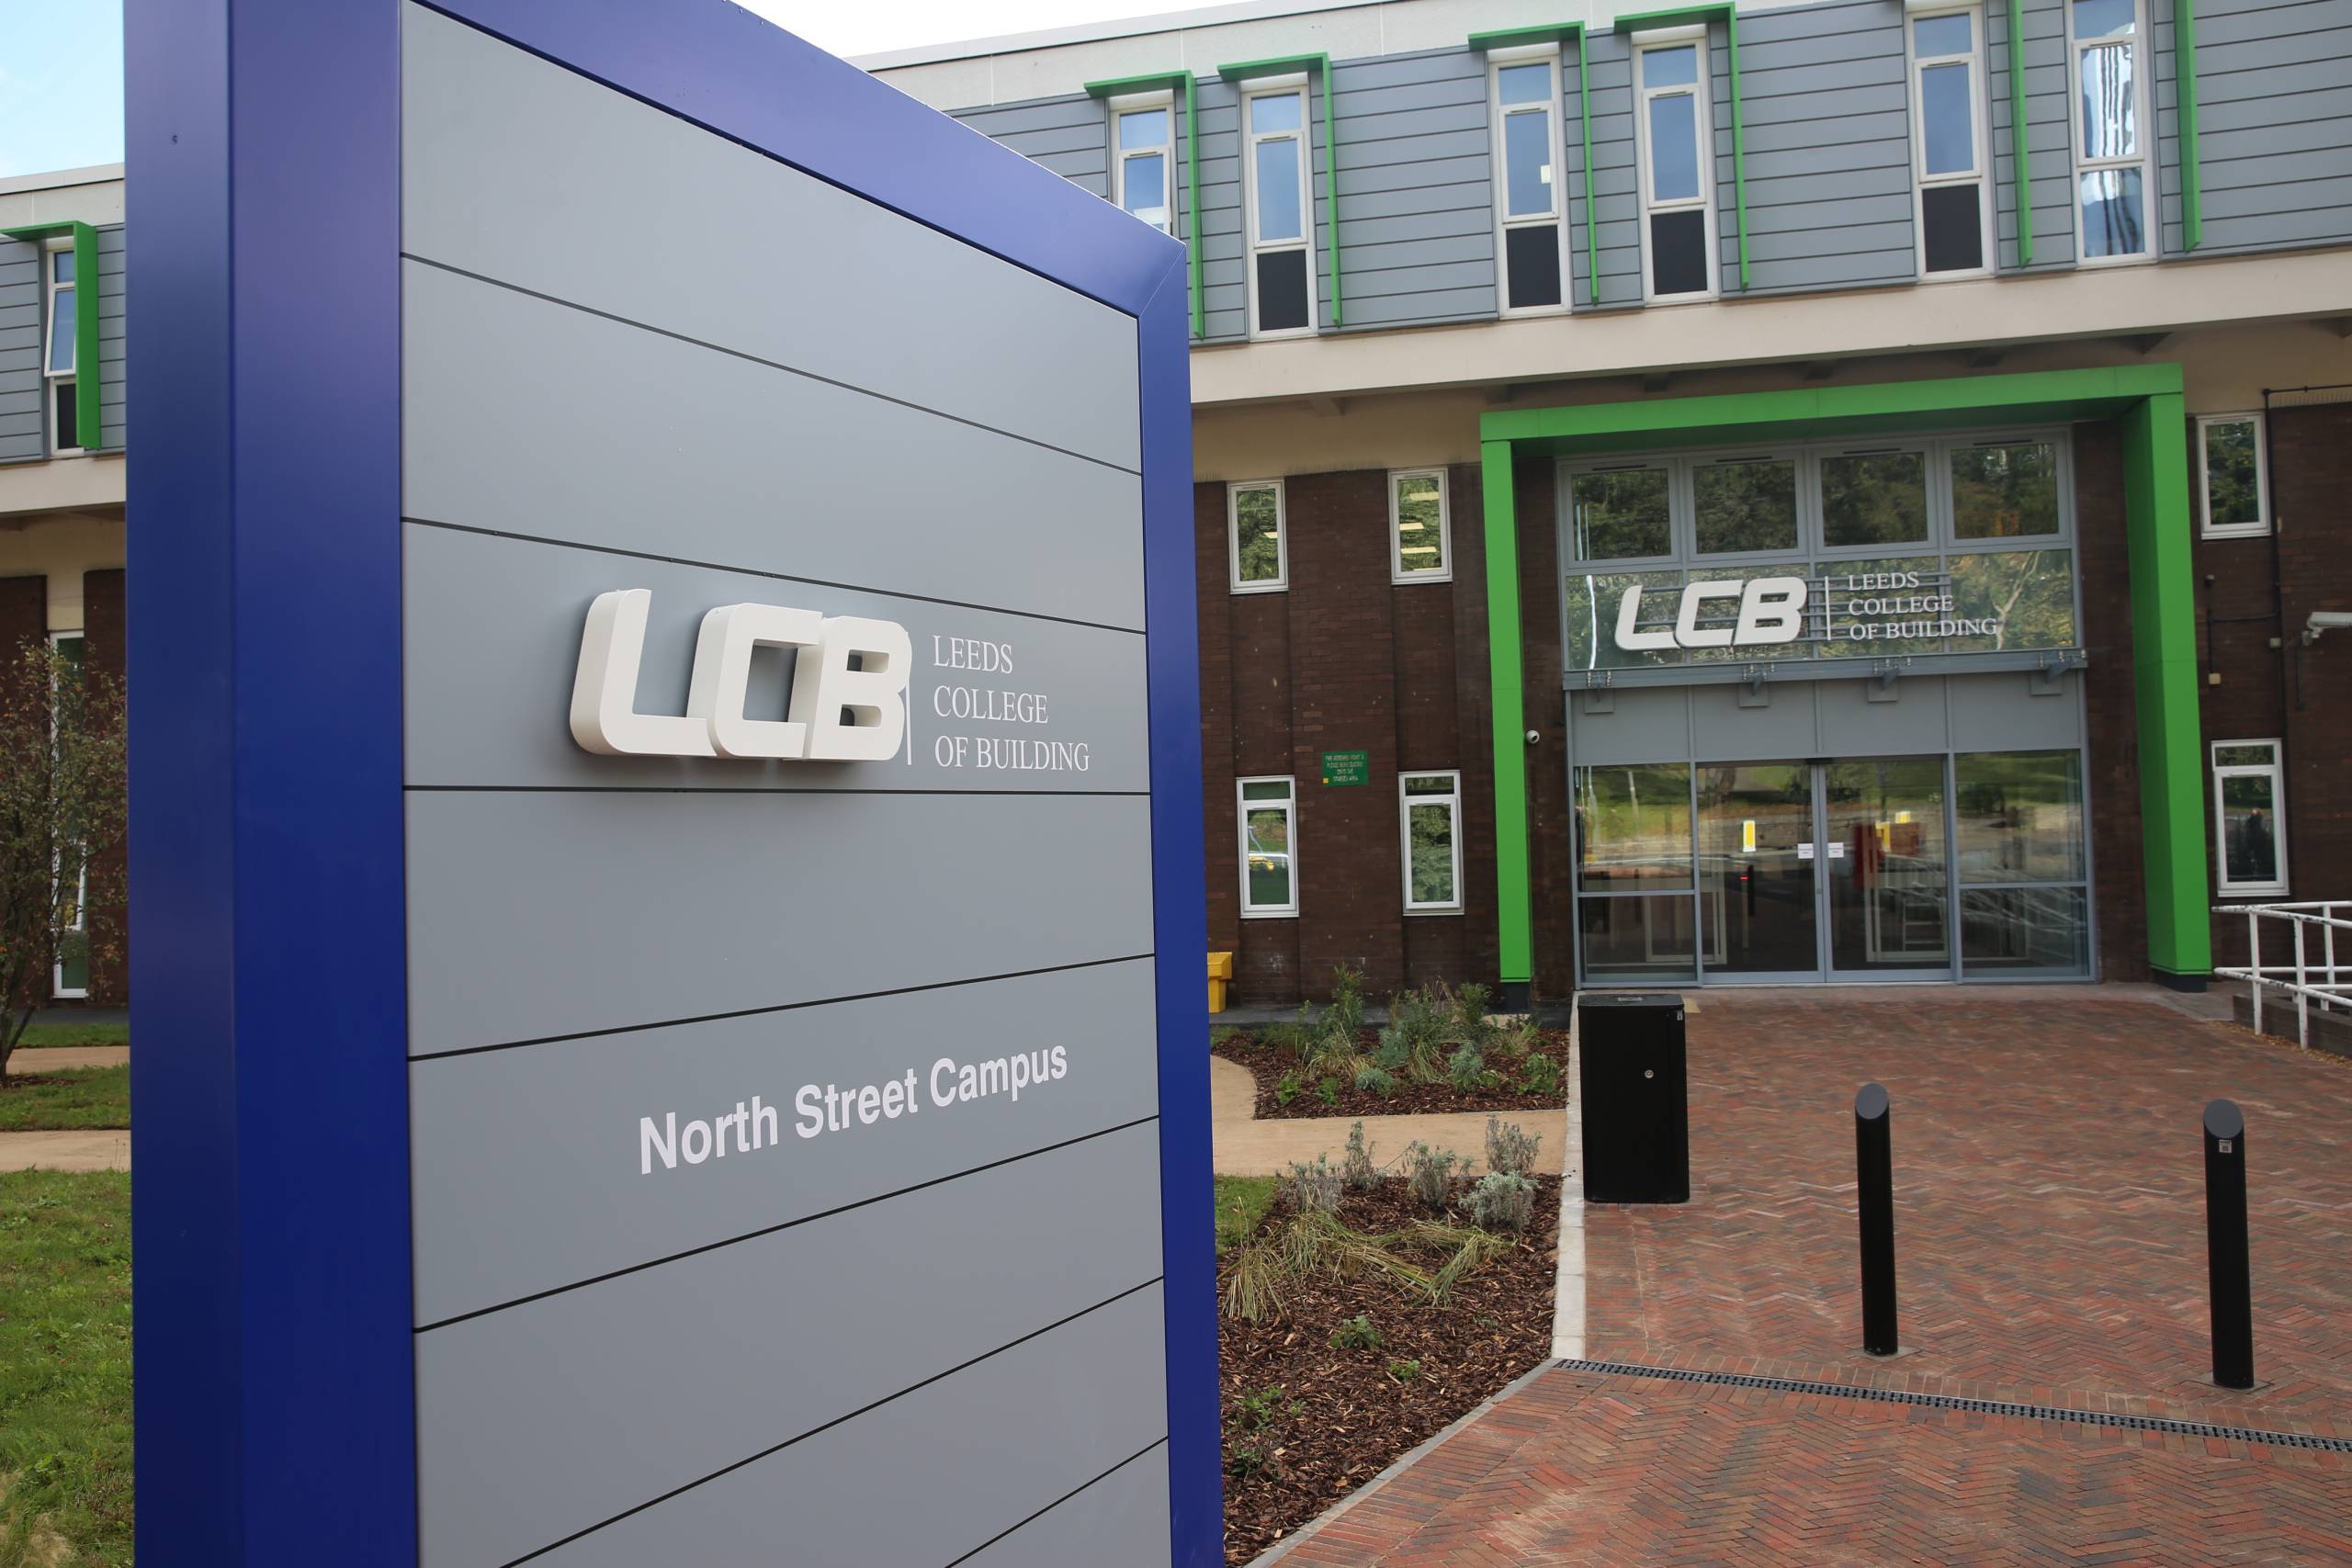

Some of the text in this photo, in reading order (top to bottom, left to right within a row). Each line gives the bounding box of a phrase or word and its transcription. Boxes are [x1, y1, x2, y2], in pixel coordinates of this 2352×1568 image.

[1848, 570, 1921, 591] LEEDS
[1615, 576, 1808, 650] LCB
[1848, 593, 1955, 616] COLLEGE
[1849, 617, 1998, 641] OF BUILDING
[570, 588, 912, 762] LCB
[933, 634, 1014, 675] LEEDS
[933, 683, 1050, 725] COLLEGE
[933, 734, 1091, 773] OF BUILDING
[639, 1044, 1069, 1176] North Street Campus
